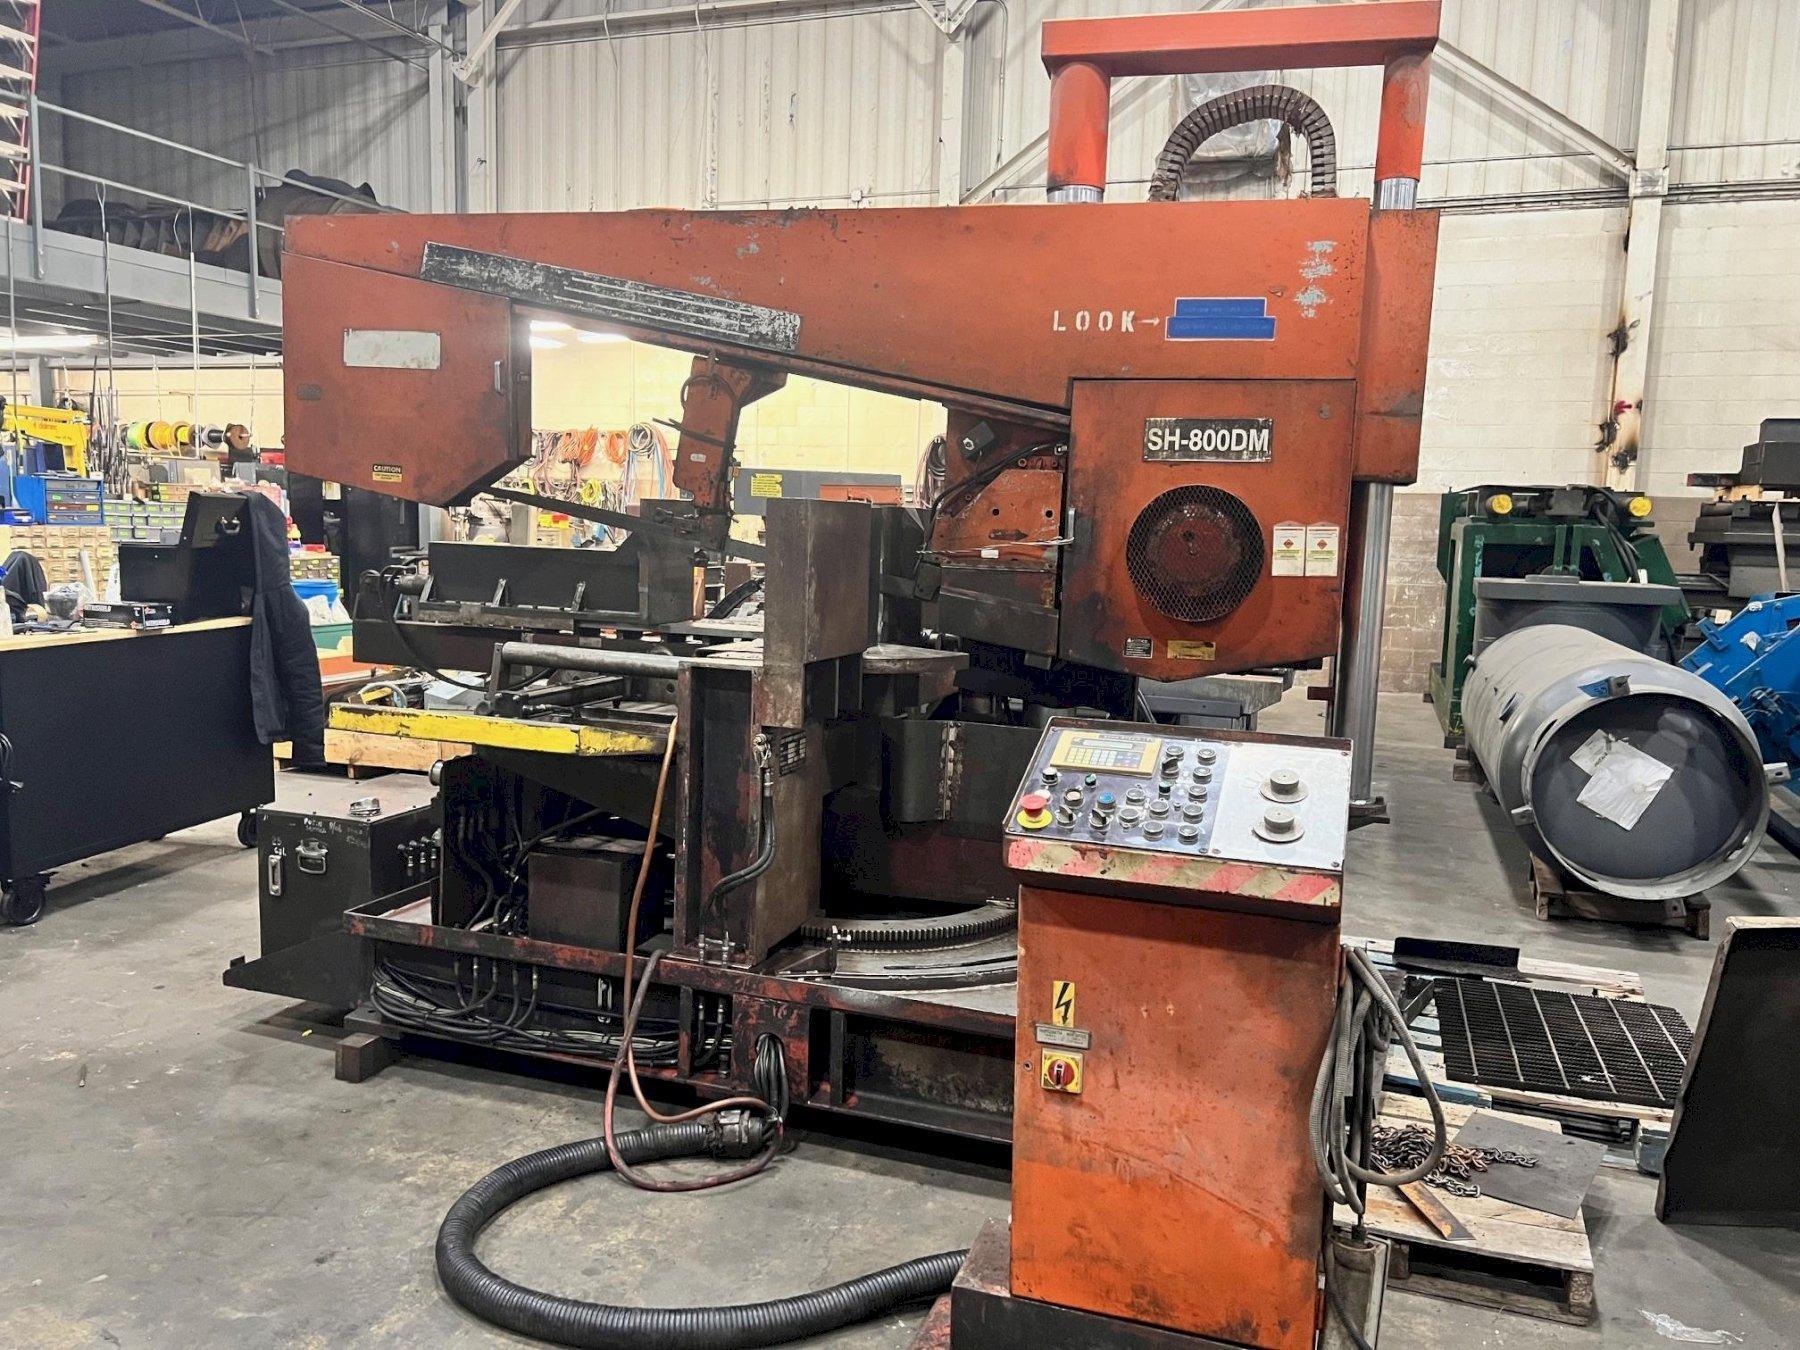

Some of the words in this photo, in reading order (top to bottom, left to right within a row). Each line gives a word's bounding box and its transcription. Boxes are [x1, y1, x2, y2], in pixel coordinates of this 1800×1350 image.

[1053, 310, 1136, 333] LOOK
[1147, 428, 1269, 451] SH-800DM
[373, 465, 401, 473] CAUTION
